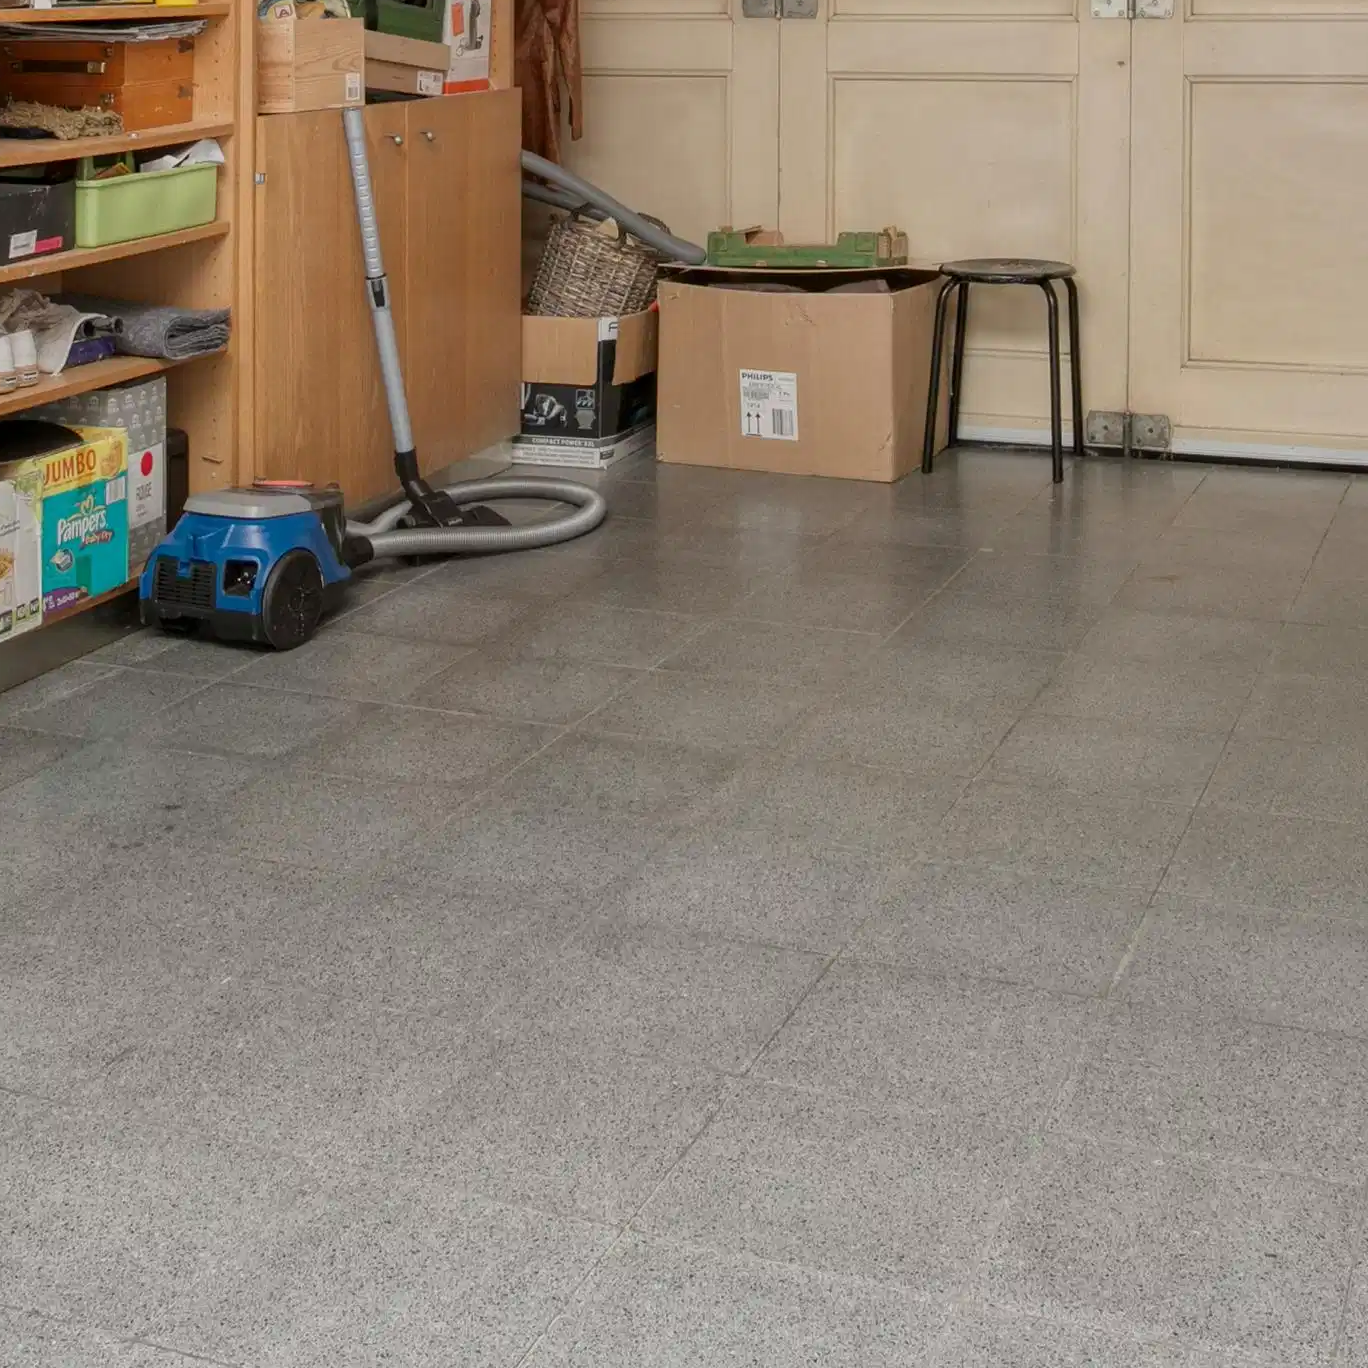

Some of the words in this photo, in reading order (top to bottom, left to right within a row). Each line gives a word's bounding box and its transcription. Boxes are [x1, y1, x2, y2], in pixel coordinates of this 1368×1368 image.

[742, 372, 773, 381] PHILIPS
[44, 448, 97, 487] JUMBO
[57, 510, 109, 546] Pampers
